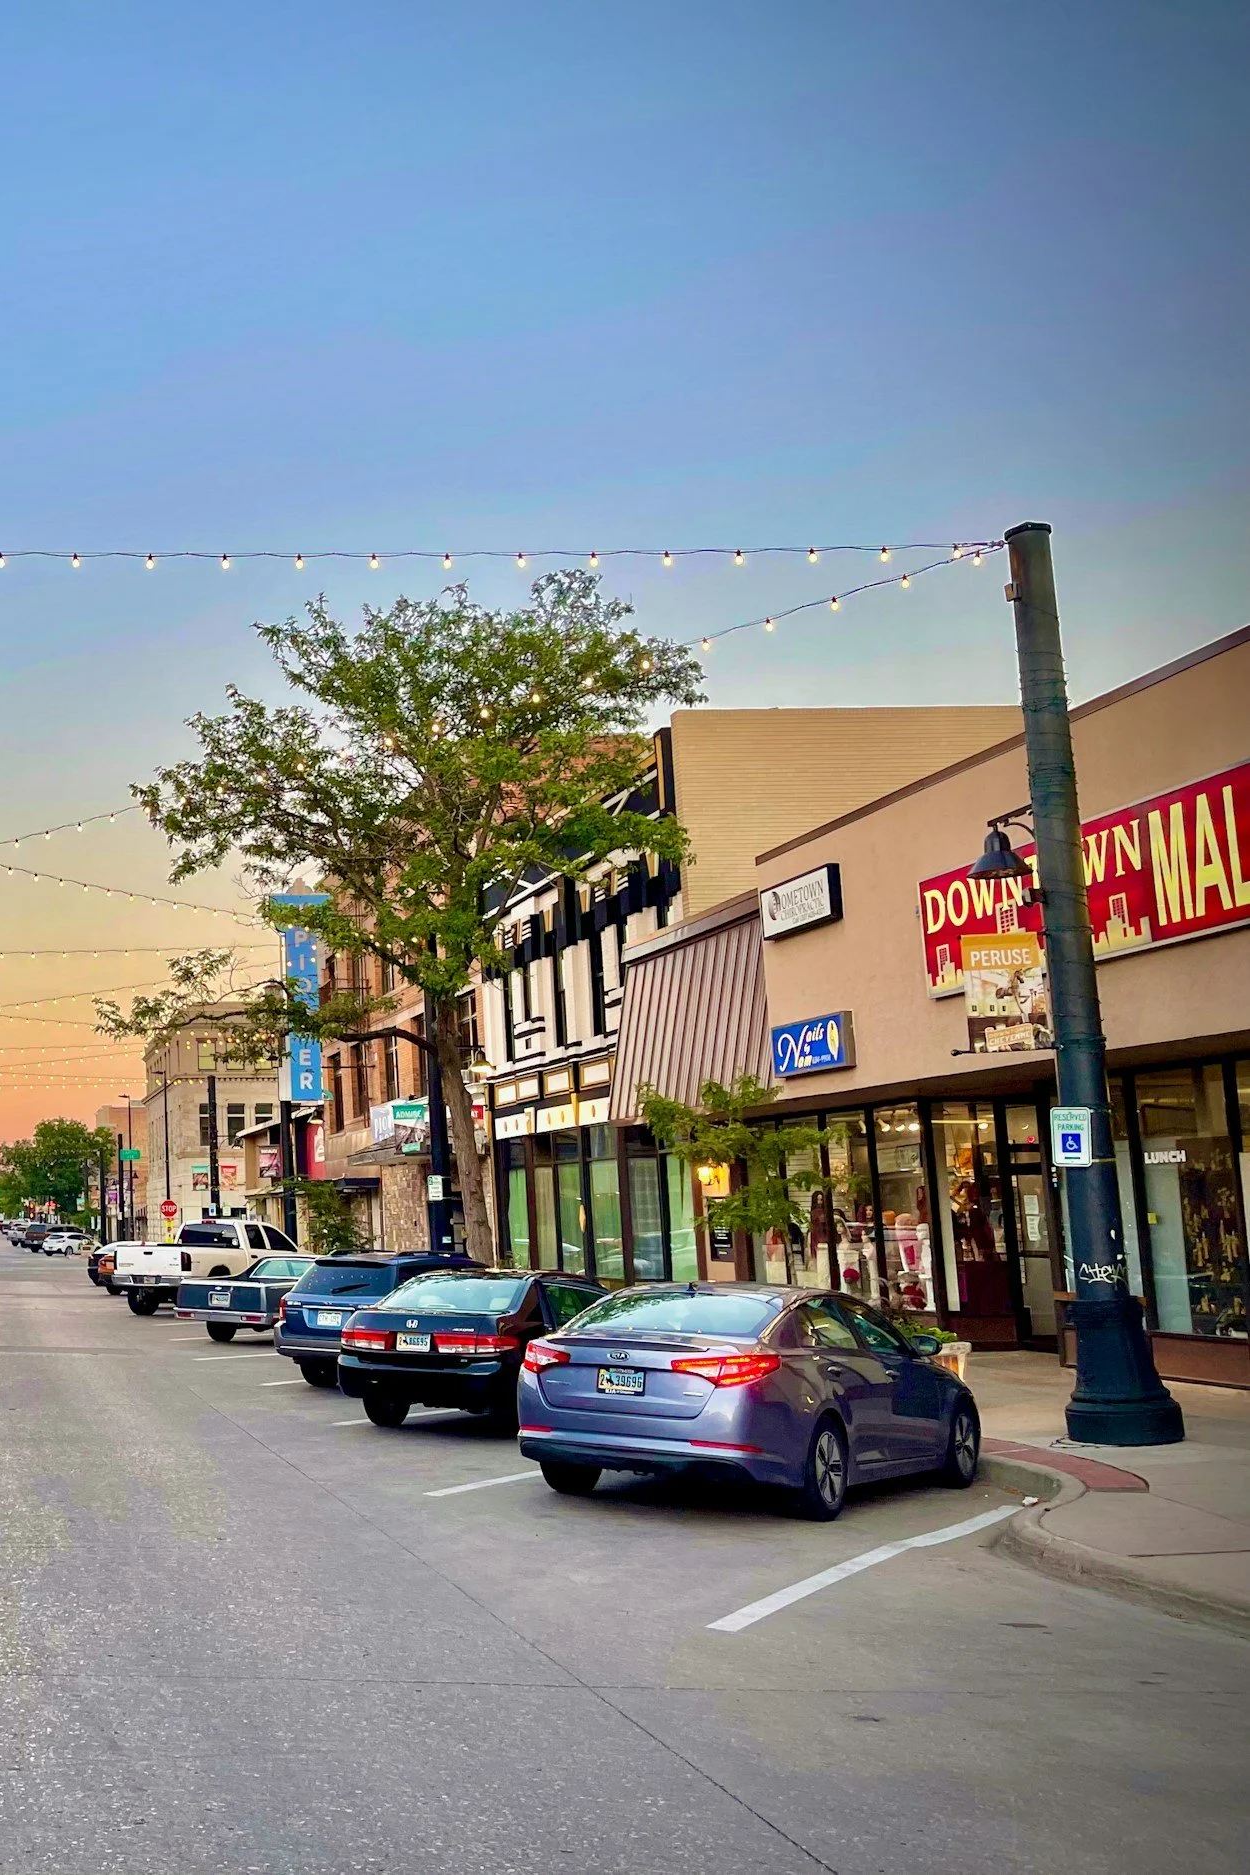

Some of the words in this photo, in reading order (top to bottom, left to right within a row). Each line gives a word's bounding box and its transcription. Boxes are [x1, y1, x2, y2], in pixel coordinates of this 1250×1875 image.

[924, 819, 1142, 934] DOWNTWN
[970, 948, 1032, 967] PERUSE
[294, 931, 314, 1090] PIOER
[778, 1023, 825, 1072] Nails
[395, 1110, 423, 1119] ADMIRE
[1053, 1113, 1087, 1121] RESERVED
[1057, 1123, 1085, 1131] PARKING
[1143, 1150, 1187, 1164] LUNCH
[600, 1373, 605, 1386] 2
